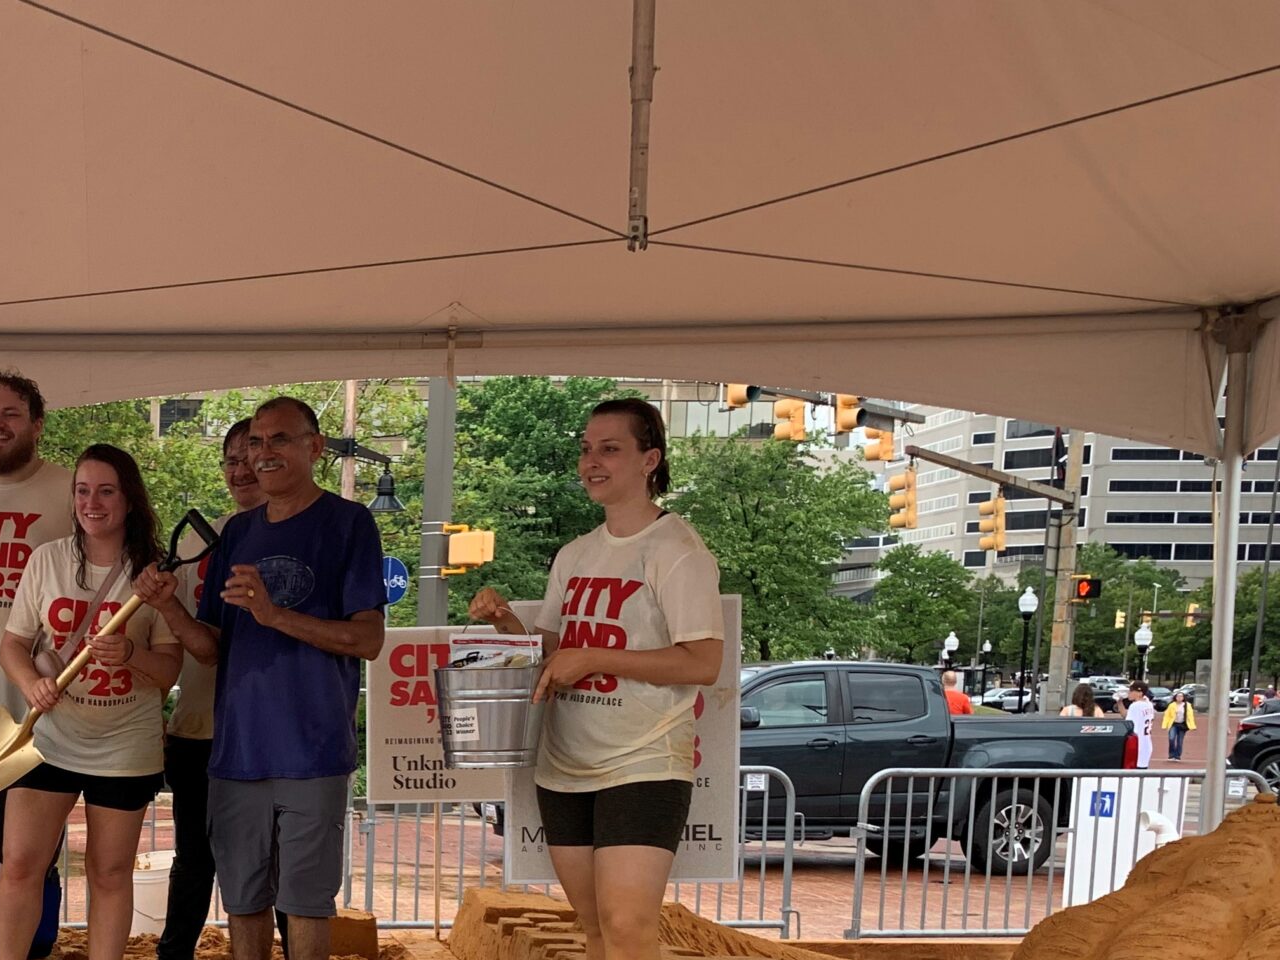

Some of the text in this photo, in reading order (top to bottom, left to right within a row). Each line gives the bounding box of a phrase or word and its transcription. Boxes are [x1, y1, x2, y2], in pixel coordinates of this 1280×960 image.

[559, 620, 628, 650] AND
[389, 643, 451, 678] CIT
[389, 680, 439, 707] SA
[385, 737, 435, 745] REIMAGINING
[392, 754, 484, 772] Unkn
[392, 772, 457, 790] Studio
